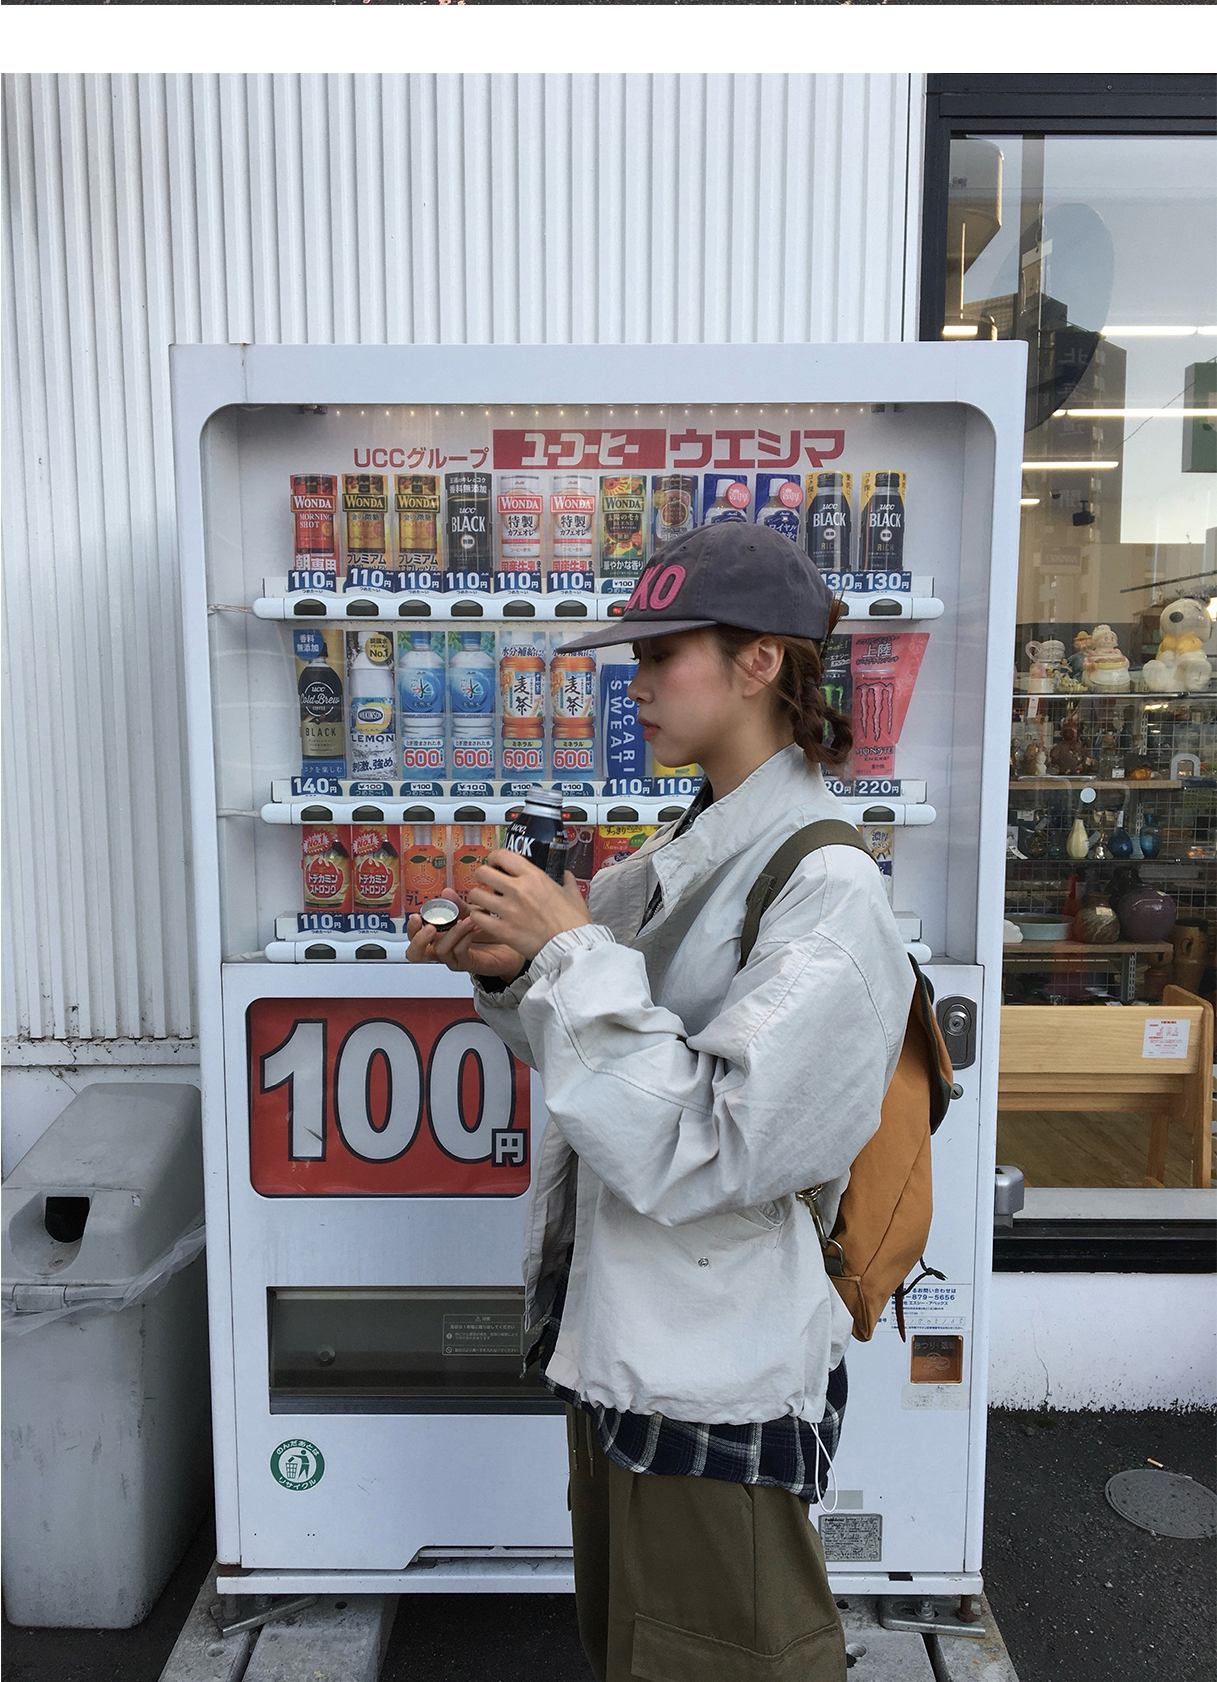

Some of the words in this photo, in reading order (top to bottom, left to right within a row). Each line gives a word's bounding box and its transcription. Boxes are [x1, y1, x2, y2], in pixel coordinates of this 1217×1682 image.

[354, 447, 489, 469] UCCグループ
[669, 428, 845, 468] ウエシマ
[293, 496, 332, 509] WONDA
[345, 496, 384, 508] WONDA
[501, 497, 539, 509] WONDA
[300, 513, 332, 521] MORNING
[508, 515, 533, 528] 特製
[560, 515, 586, 528] 特製
[813, 512, 846, 527] BLACK
[869, 513, 901, 528] BLACK
[452, 517, 486, 533] BLACK
[348, 553, 386, 565] プレミアム
[603, 560, 644, 571] 華やかな香り
[291, 571, 333, 588] 110円
[350, 568, 392, 588] 110円
[398, 571, 439, 588] 110円
[866, 573, 910, 590] 130円
[297, 643, 319, 653] 無添加
[369, 649, 389, 658] No.1
[863, 643, 892, 658] 上陸
[514, 675, 532, 715] 麦茶
[564, 675, 584, 715] 麦茶
[352, 734, 394, 742] LEMON
[404, 750, 440, 767] 600
[454, 750, 489, 767] 600
[293, 777, 337, 794] 140円
[858, 781, 899, 794] 220円
[308, 873, 338, 884] ドデカミン
[358, 873, 388, 884] ドデカミン
[310, 885, 337, 894] ストロング
[360, 885, 387, 894] ストロング
[259, 1018, 528, 1168] 100円
[276, 1440, 319, 1456] のんだあとは
[279, 1477, 316, 1489] リサイクル
